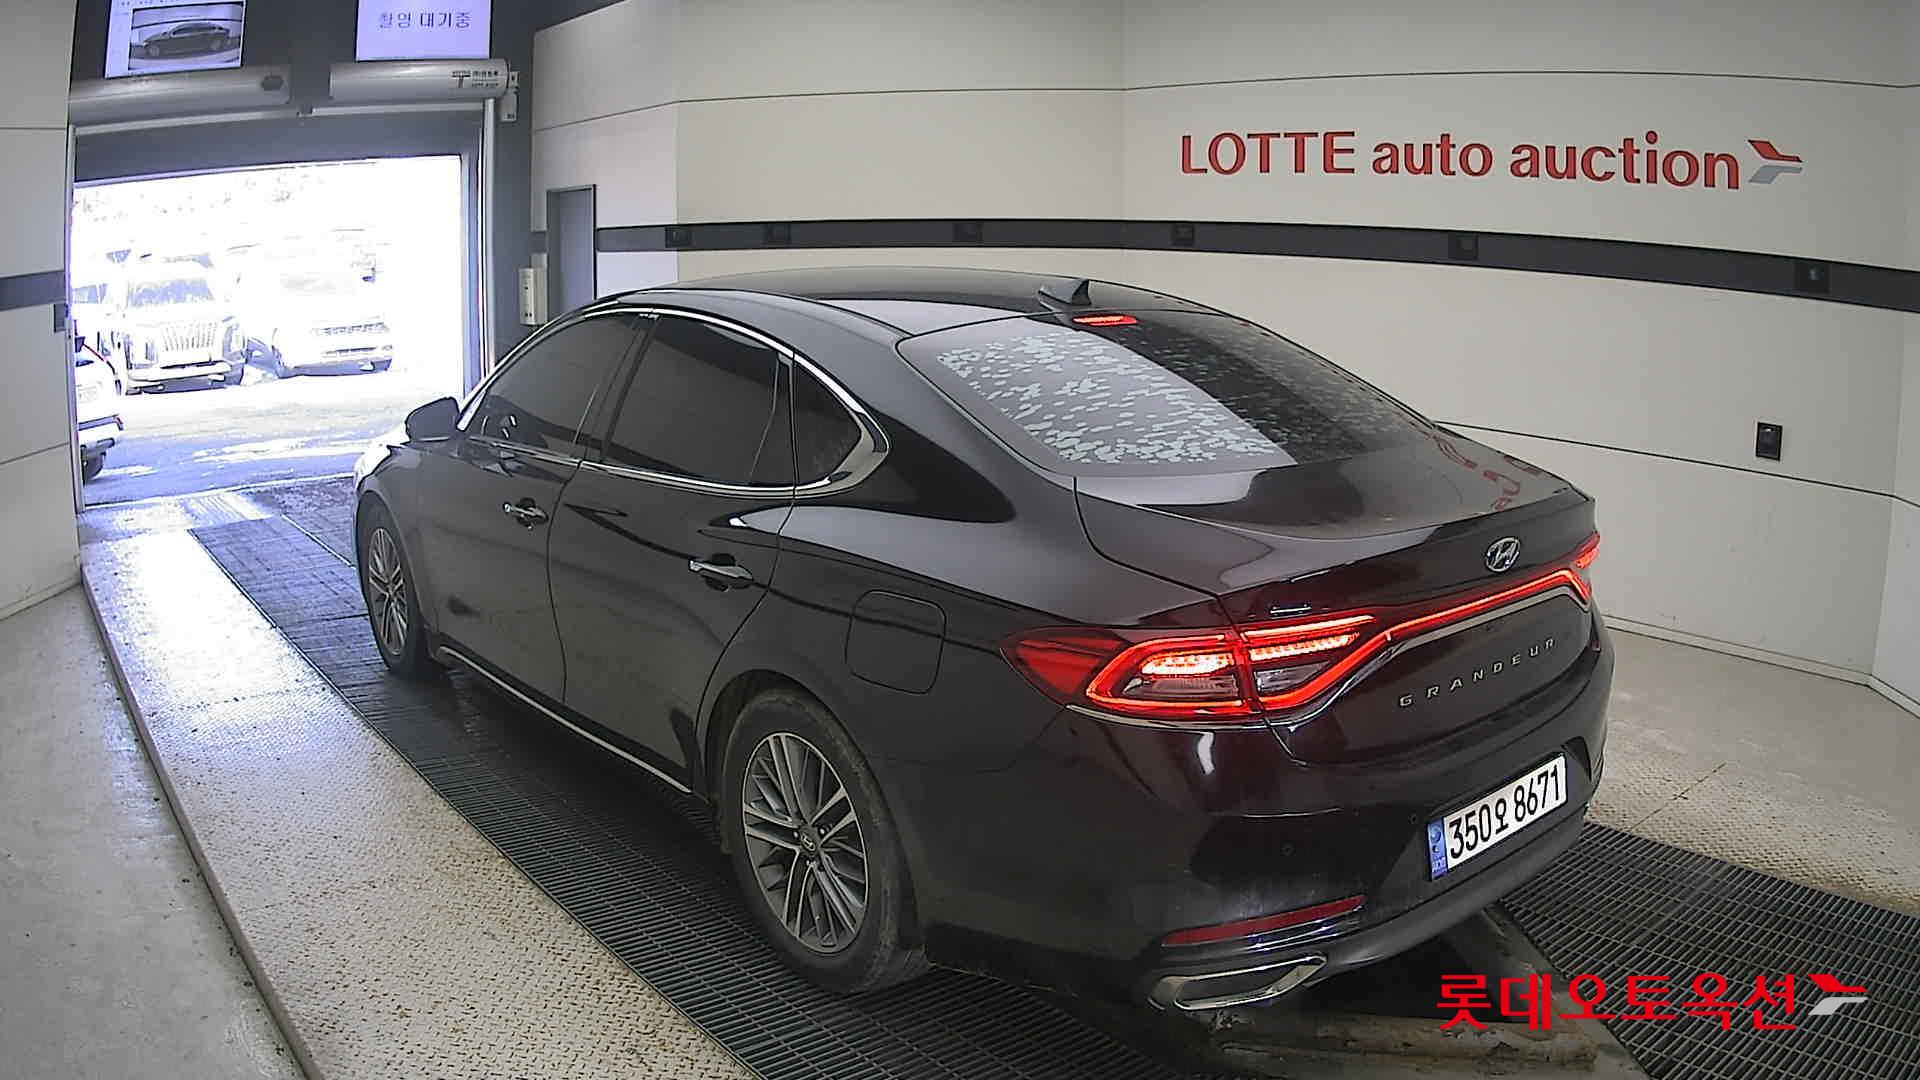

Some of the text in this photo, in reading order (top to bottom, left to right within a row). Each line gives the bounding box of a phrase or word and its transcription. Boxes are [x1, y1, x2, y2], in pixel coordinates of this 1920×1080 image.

[420, 11, 473, 29] 대기중
[1180, 130, 1741, 190] LOTTE auto auction
[1398, 637, 1556, 708] GRANDEUR
[1448, 763, 1561, 860] 350오 8671
